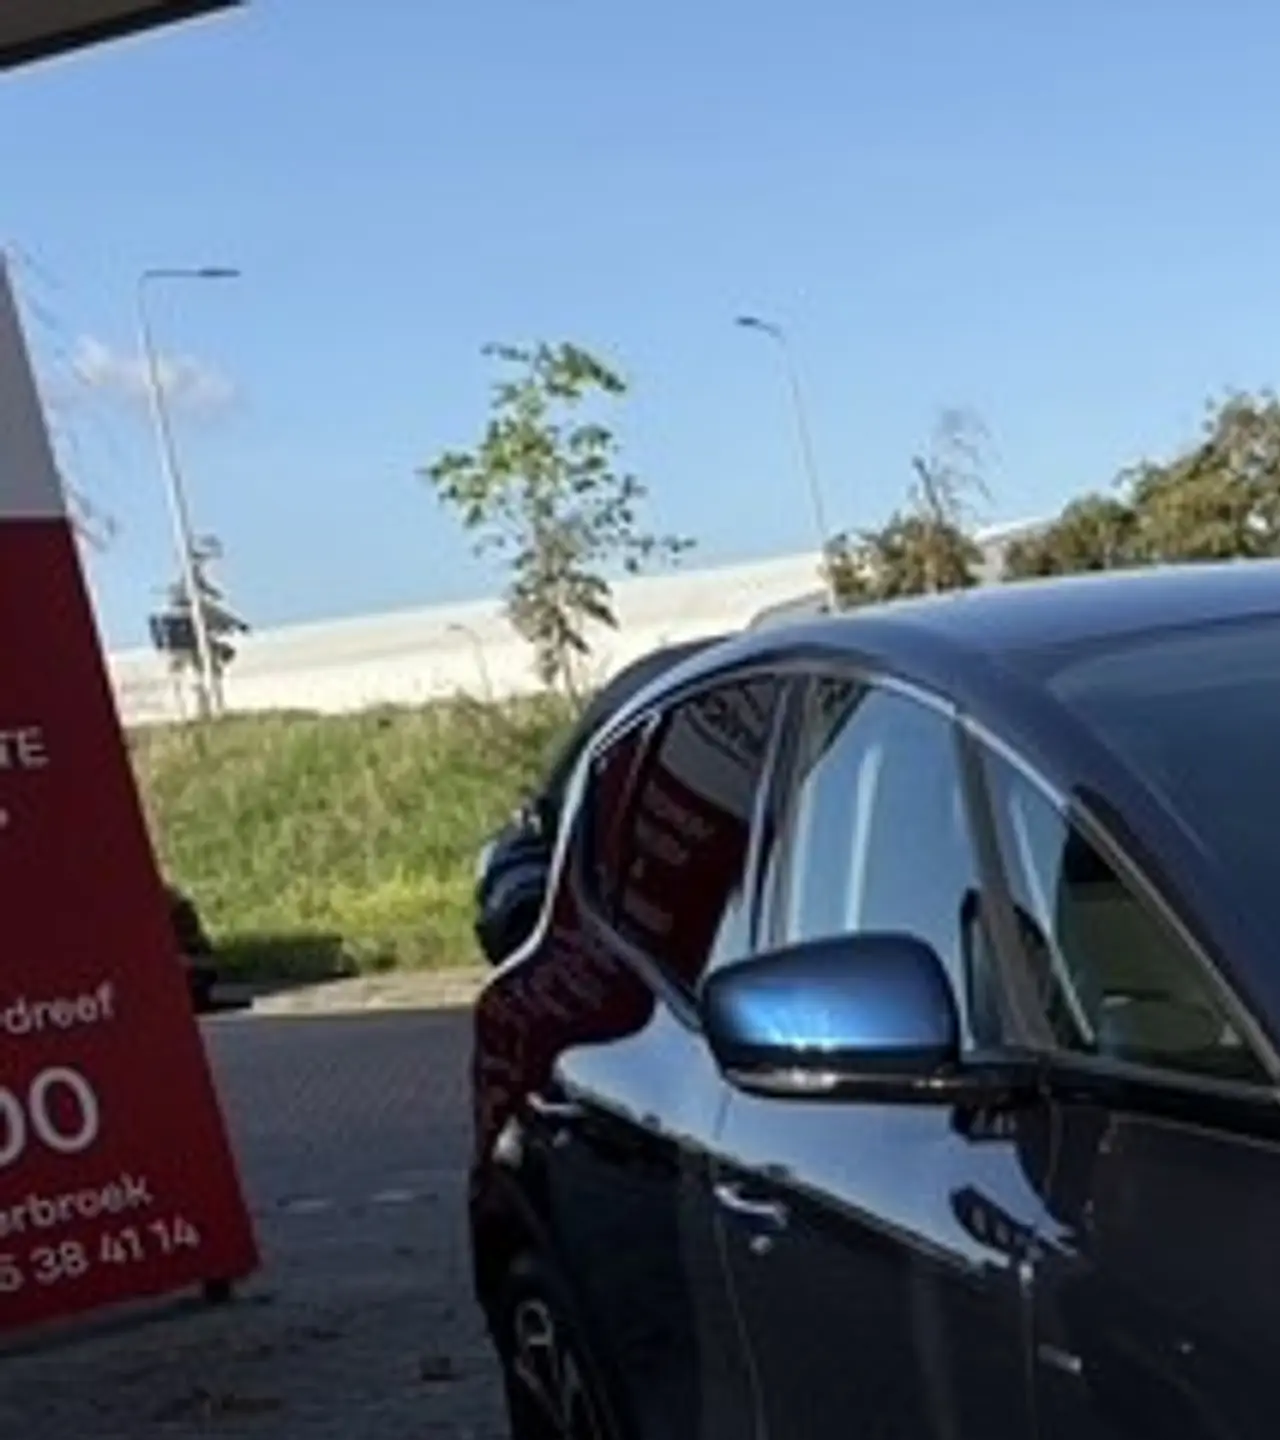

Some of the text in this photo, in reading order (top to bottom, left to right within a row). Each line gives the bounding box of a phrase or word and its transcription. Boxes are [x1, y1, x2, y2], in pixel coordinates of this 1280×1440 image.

[0, 980, 114, 1034] dreef
[29, 1239, 90, 1287] 38
[99, 1226, 146, 1264] 41
[147, 1213, 201, 1254] 14
